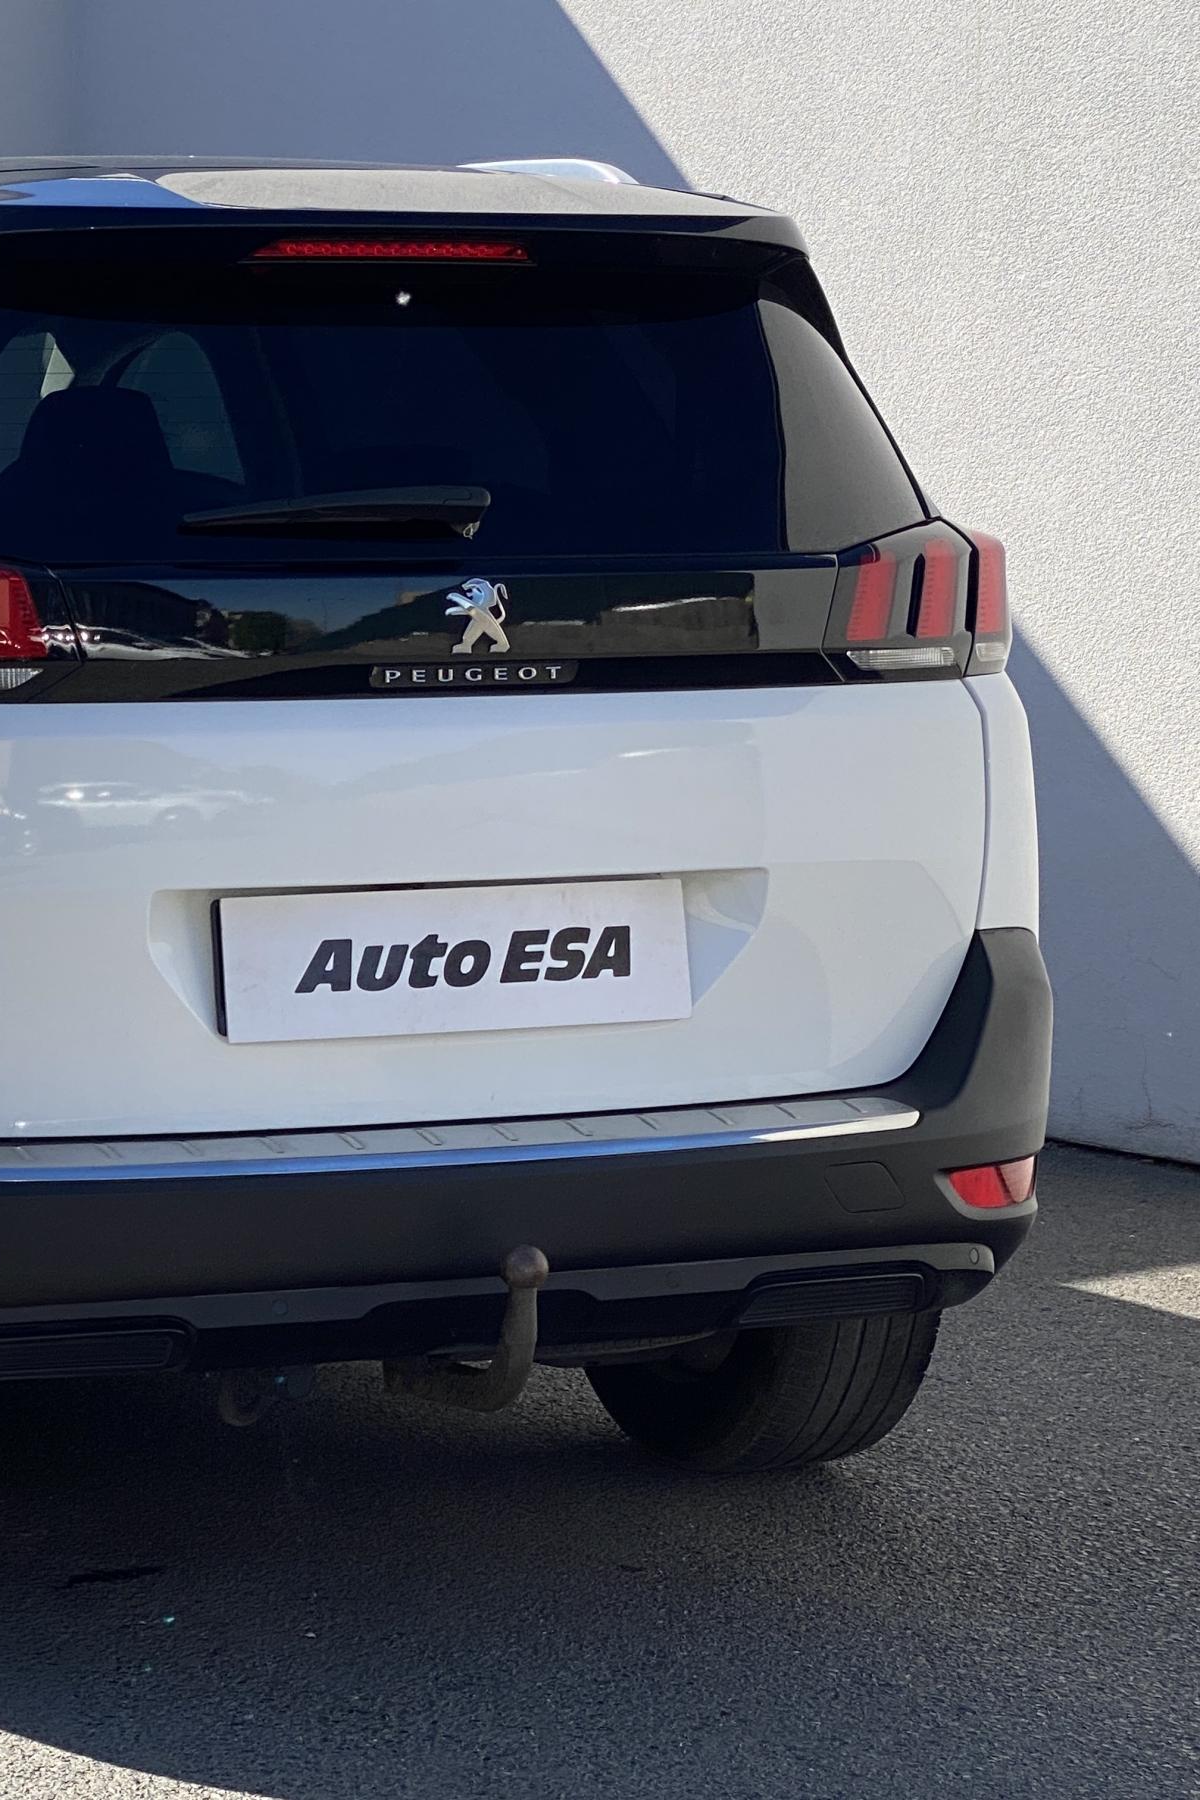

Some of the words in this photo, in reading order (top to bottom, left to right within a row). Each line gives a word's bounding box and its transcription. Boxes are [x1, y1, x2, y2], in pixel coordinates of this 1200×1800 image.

[385, 666, 561, 683] PEUGEOT
[295, 934, 491, 993] Auto
[500, 926, 630, 983] ESA
